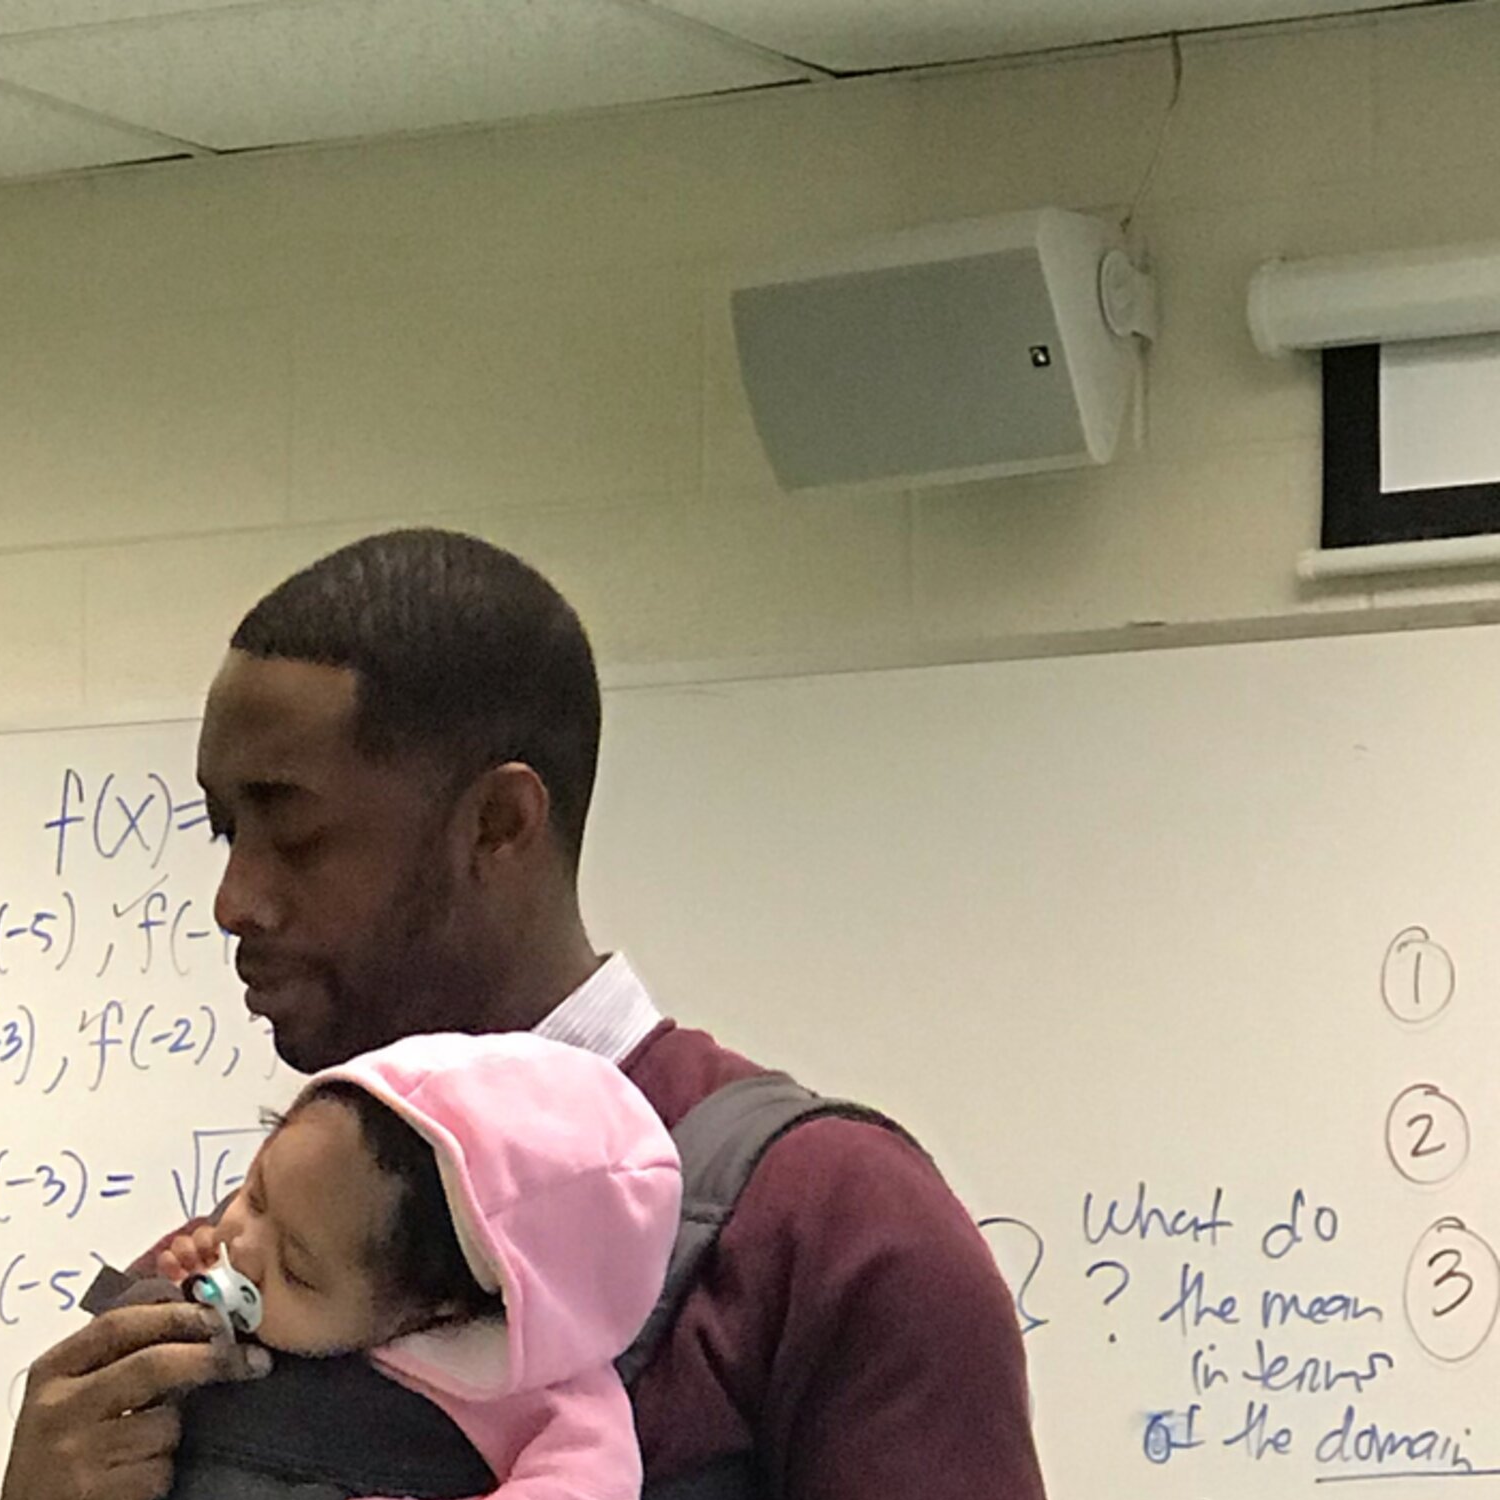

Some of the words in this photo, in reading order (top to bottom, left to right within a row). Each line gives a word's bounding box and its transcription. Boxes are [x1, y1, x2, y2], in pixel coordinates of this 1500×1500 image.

[1082, 1180, 1234, 1247] What
[1261, 1187, 1339, 1260] do
[1241, 1338, 1394, 1394] terms
[1222, 1400, 1293, 1461] the
[1313, 1404, 1475, 1473] domain
